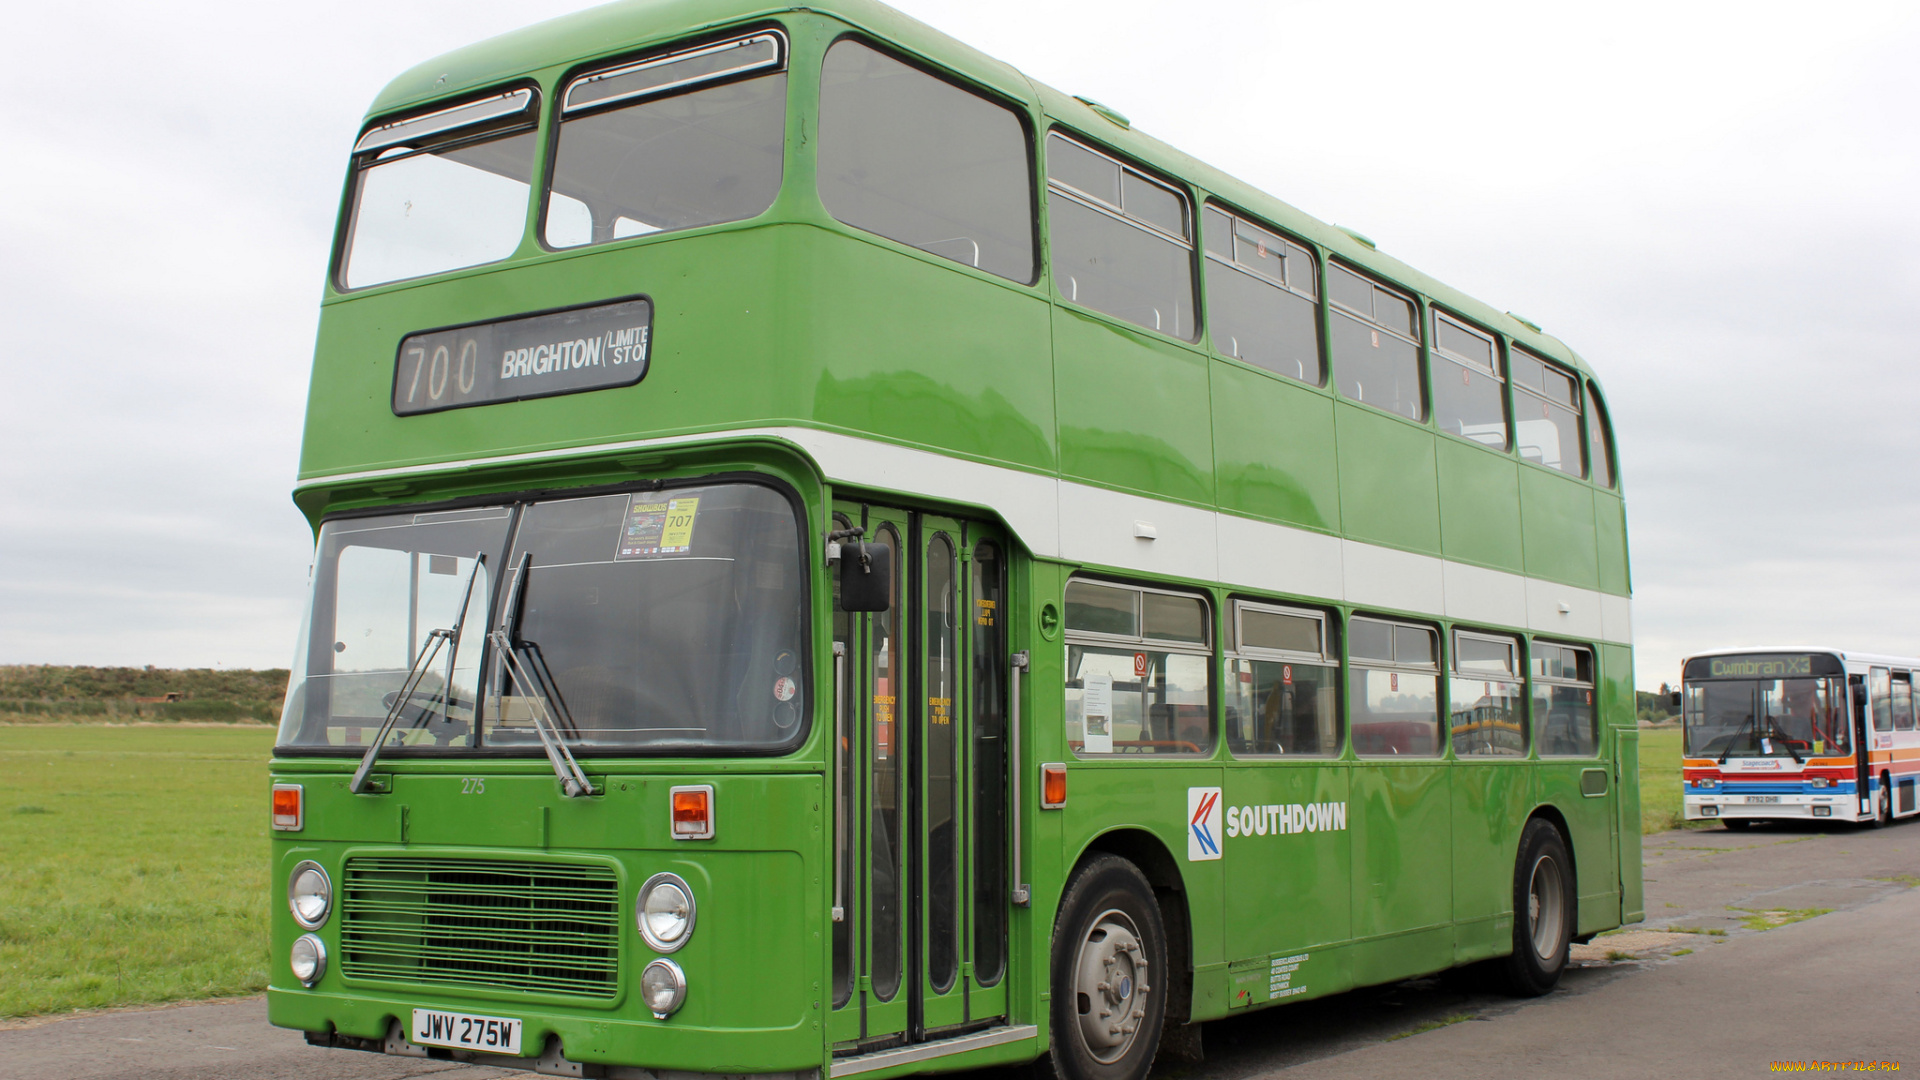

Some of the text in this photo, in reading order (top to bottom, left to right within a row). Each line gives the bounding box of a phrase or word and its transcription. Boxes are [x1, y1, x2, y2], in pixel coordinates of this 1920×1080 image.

[408, 336, 602, 403] 700 BRIGHTON
[669, 515, 692, 528] 707
[1711, 657, 1811, 676] Cwmbran X3
[461, 777, 485, 794] 275
[1226, 801, 1347, 838] SOUTHDOWN
[420, 1014, 512, 1048] JWV 275W
